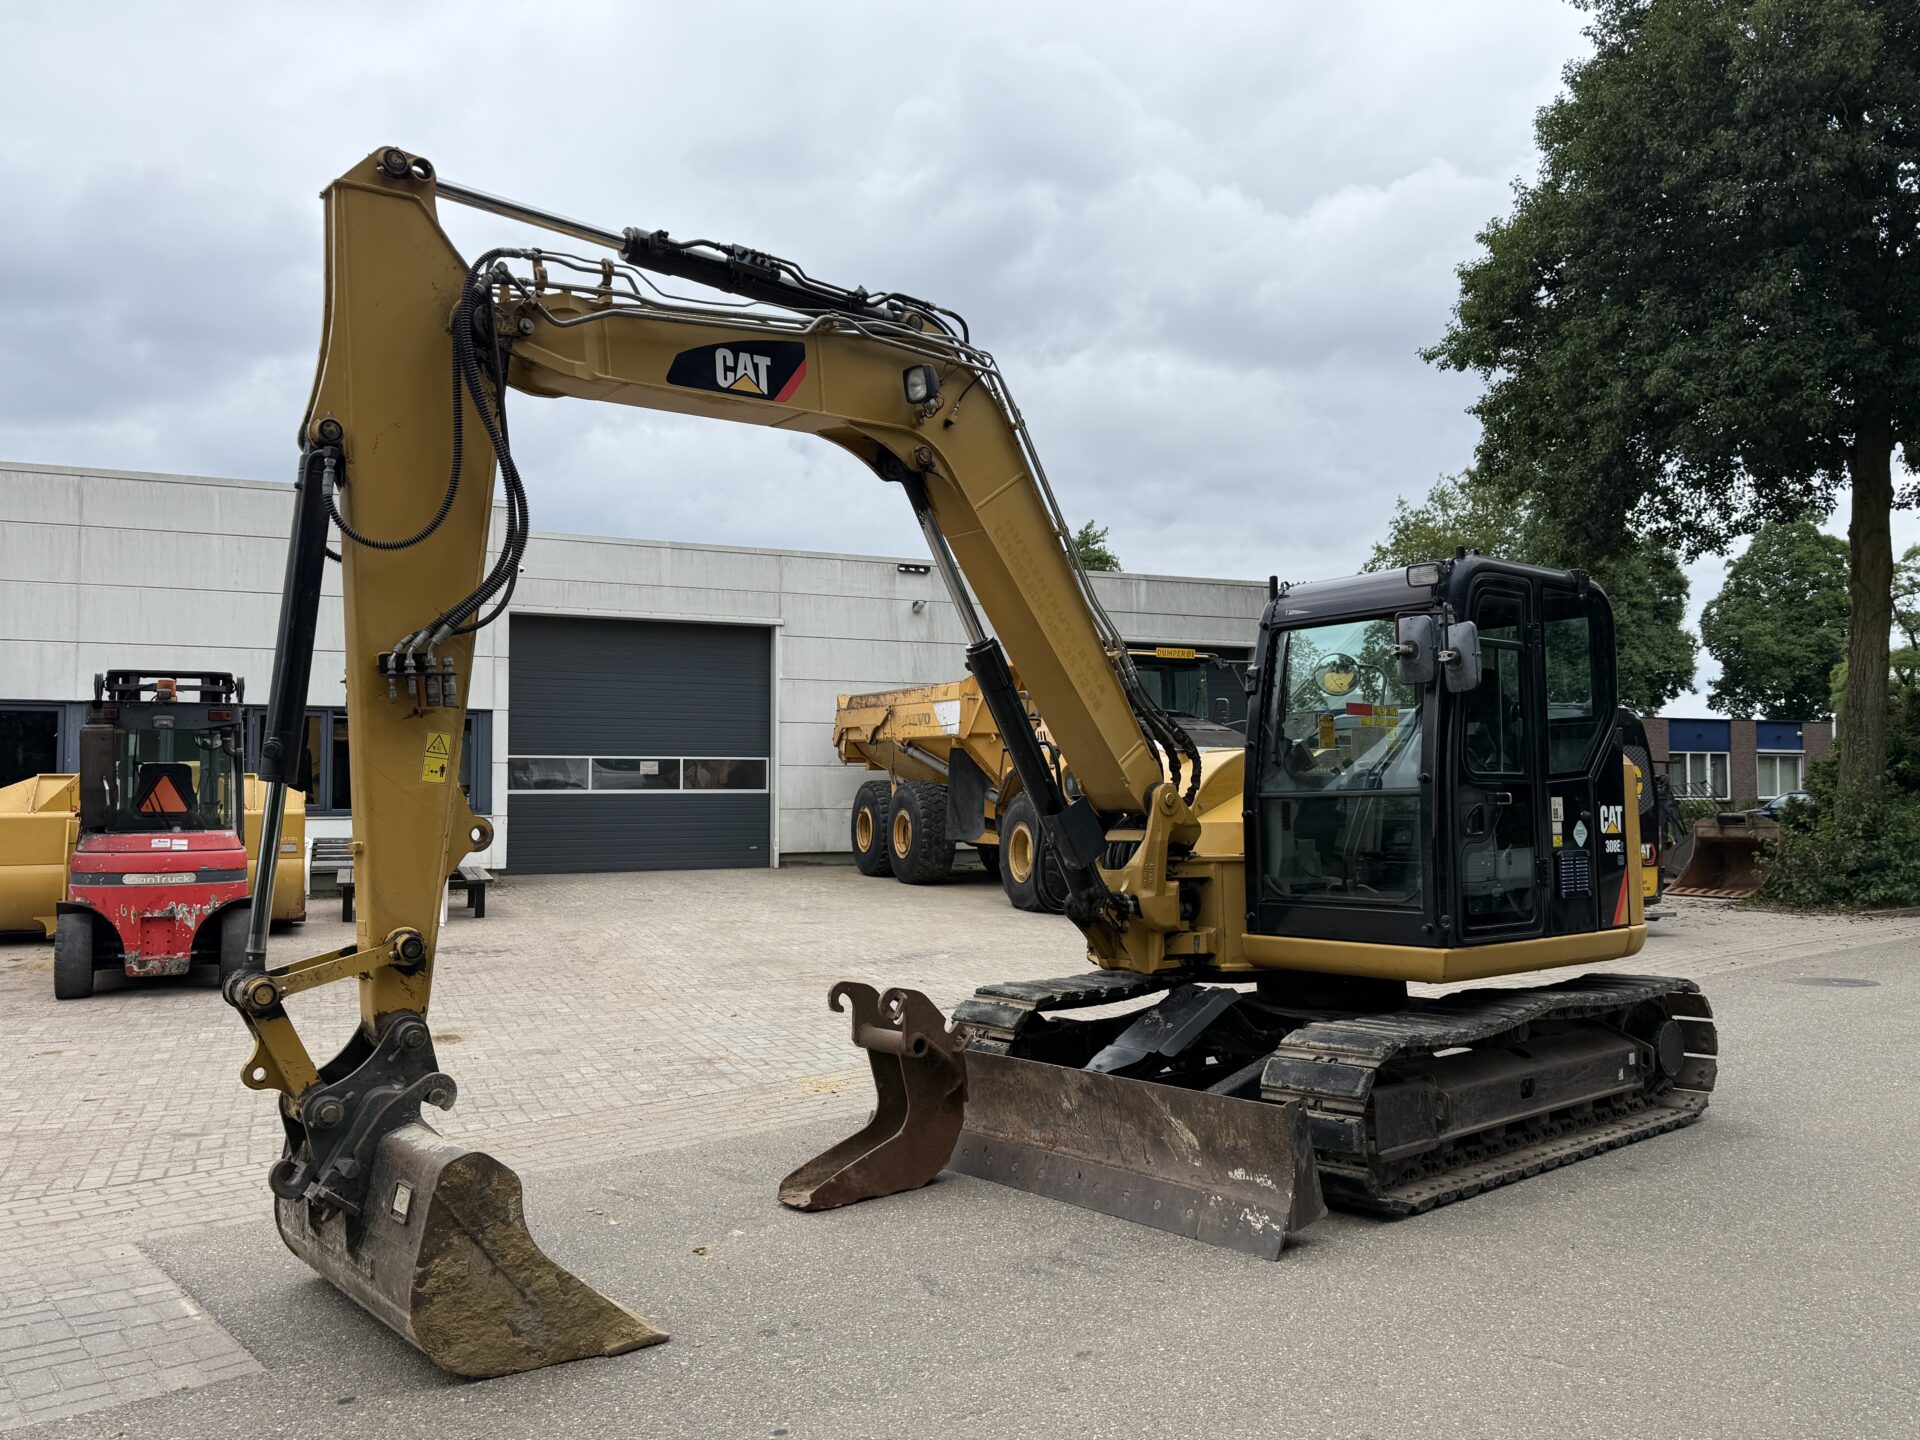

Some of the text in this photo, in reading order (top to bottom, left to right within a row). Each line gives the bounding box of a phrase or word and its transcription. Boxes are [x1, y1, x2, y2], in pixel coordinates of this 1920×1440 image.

[715, 348, 771, 395] CAT
[1600, 805, 1623, 834] CAT
[1641, 843, 1651, 860] AT
